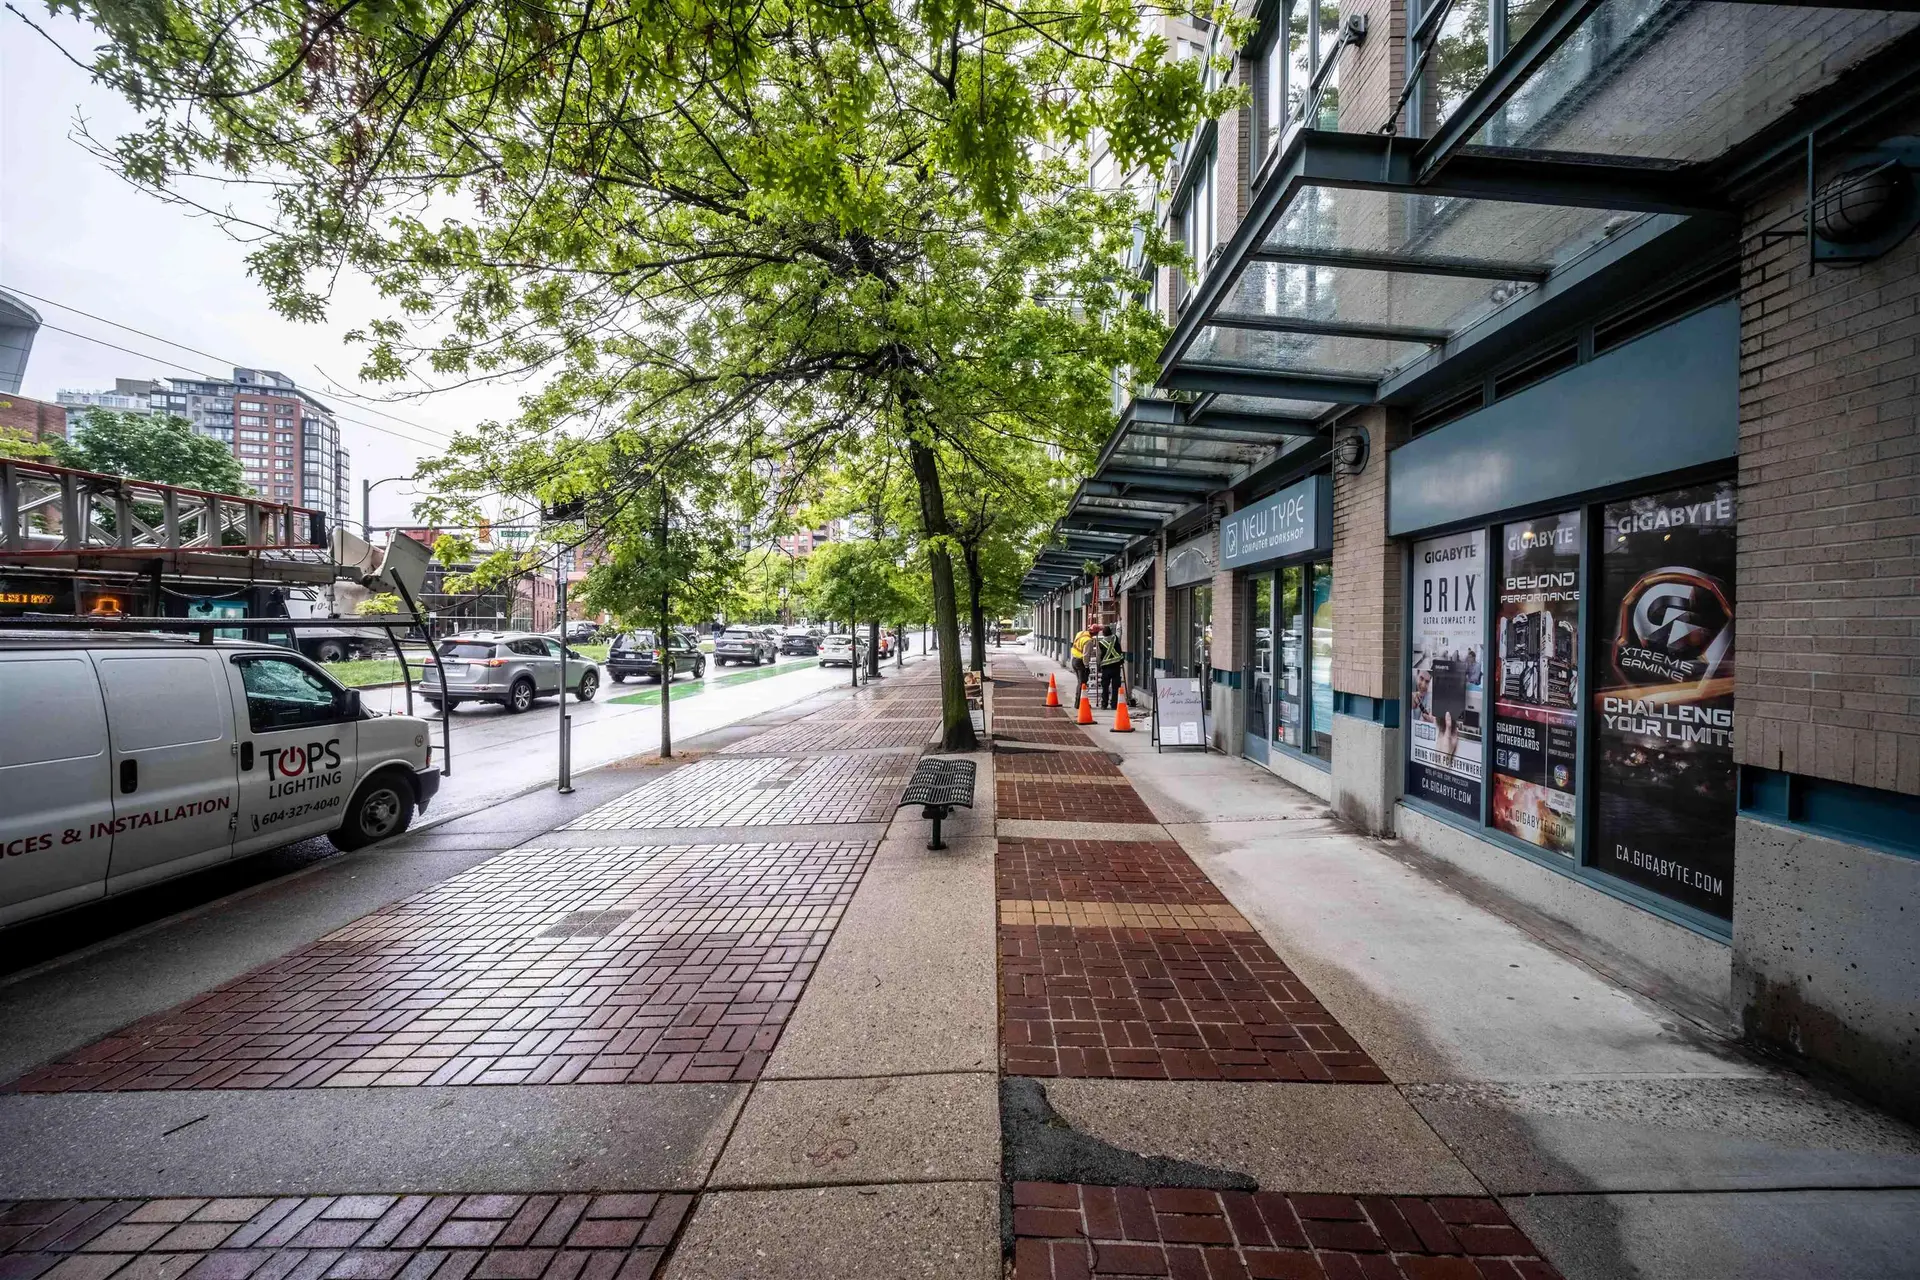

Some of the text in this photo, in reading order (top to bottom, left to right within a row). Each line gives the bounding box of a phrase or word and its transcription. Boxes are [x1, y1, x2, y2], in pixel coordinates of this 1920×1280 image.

[1242, 494, 1304, 543] NEW TYPE
[1617, 498, 1731, 535] GIGABYTE
[1241, 526, 1304, 554] COMPUTER WORKSHOP
[1507, 526, 1573, 551] GIGABYTE
[1424, 544, 1477, 564] GIGABYTE
[1505, 571, 1575, 591] BEYOND
[1500, 590, 1581, 604] PERFORMANCE
[1423, 616, 1476, 625] ULTRA COMPACT PC
[1620, 646, 1694, 675] XTREME
[1621, 657, 1685, 683] GAMING
[1603, 697, 1735, 727] CHALLENG
[1603, 714, 1662, 737] YOUR
[1496, 722, 1522, 736] GIGABYTE
[1523, 727, 1536, 739] X99
[1496, 733, 1540, 751] MOTHERBOARDS
[260, 738, 341, 781] TOPS
[1414, 747, 1428, 760] BRING
[1429, 751, 1441, 764] YOUR
[269, 771, 342, 799] LIGHTING
[1421, 777, 1473, 805] CA.GIGABYTE.COM
[61, 828, 82, 845] &
[90, 795, 230, 840] INSTALLATION
[1616, 843, 1724, 897] CA.GIGABYTE.COM
